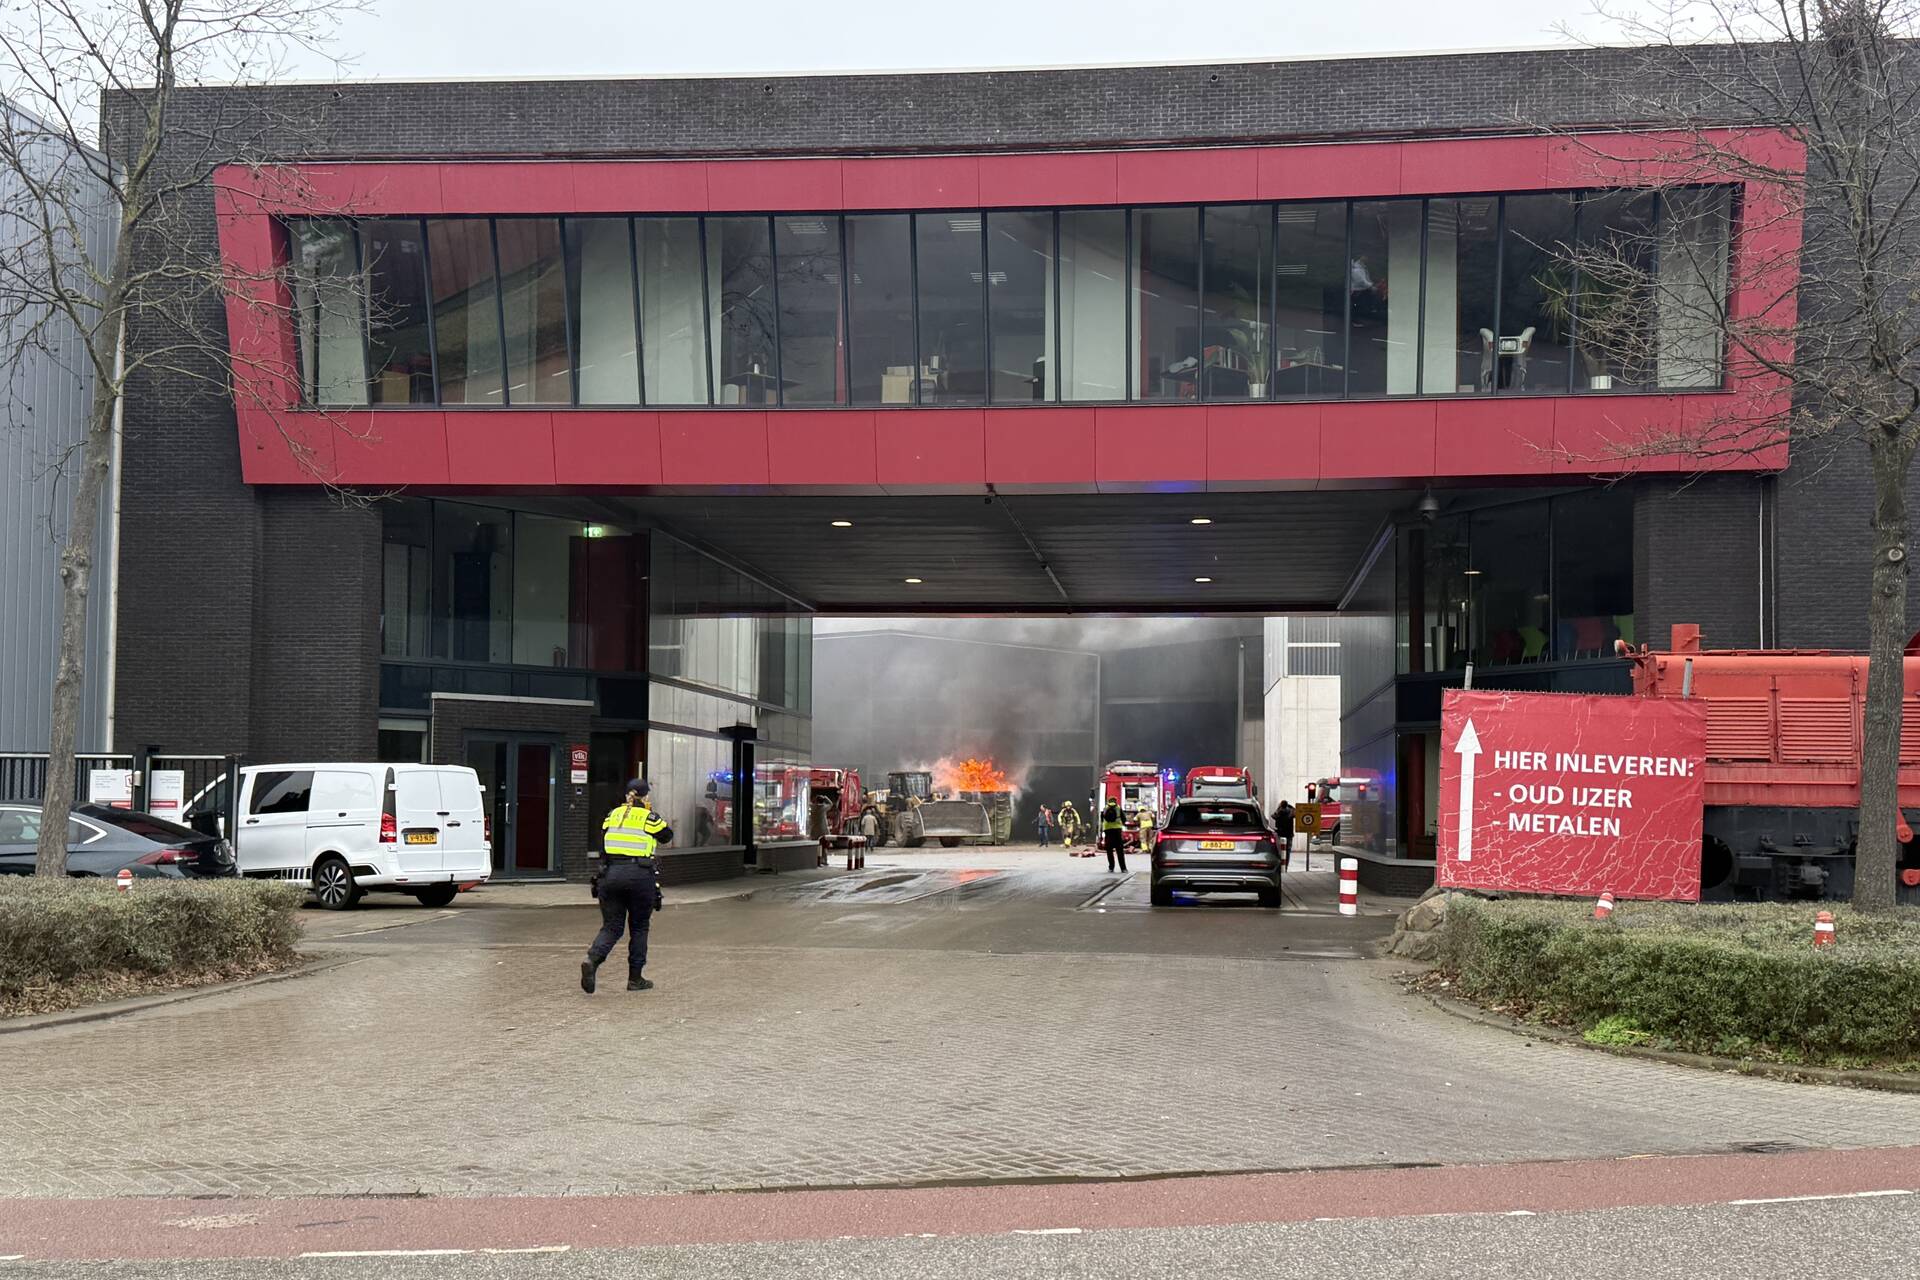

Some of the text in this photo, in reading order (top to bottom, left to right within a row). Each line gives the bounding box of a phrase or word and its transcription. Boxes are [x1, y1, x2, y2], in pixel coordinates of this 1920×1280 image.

[1494, 750, 1694, 777] HIER INLEVEREN:
[1508, 783, 1565, 805] OUD
[1572, 786, 1633, 809] IJZER
[1508, 812, 1621, 837] METALEN
